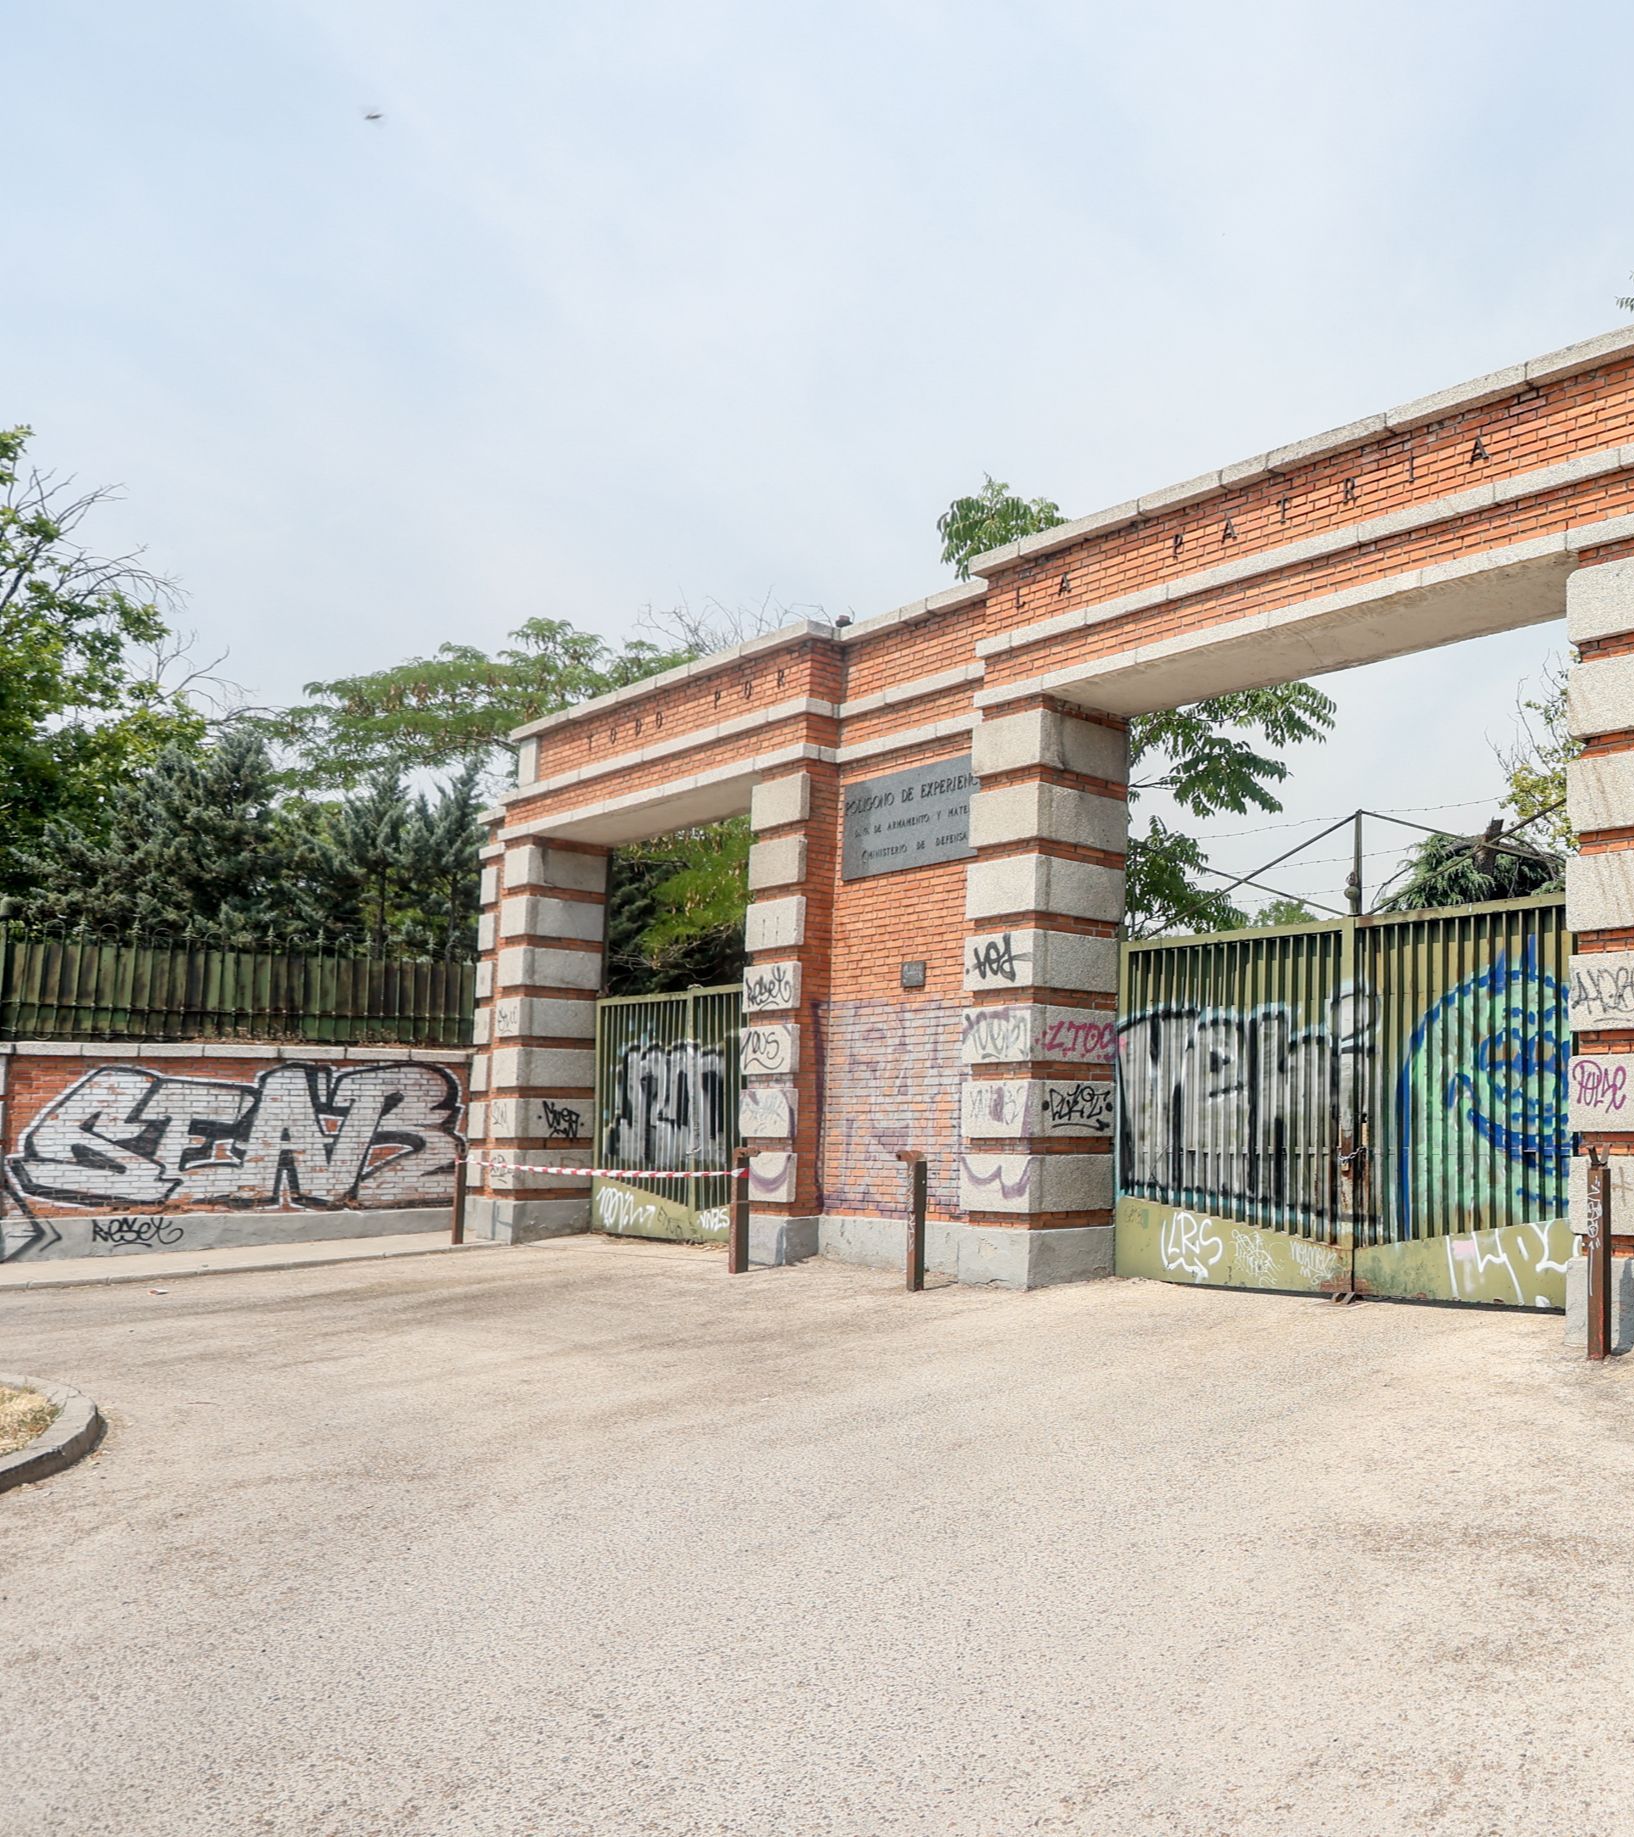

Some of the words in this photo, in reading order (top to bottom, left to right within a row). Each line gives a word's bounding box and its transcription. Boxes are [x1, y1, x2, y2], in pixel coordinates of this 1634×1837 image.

[1014, 571, 1073, 610] LA
[1172, 436, 1491, 562] PATRIA
[586, 710, 665, 751] TODO
[714, 668, 786, 711] POR
[901, 786, 914, 804] DE
[887, 813, 930, 831] ARMAMENTO
[937, 810, 942, 821] Y
[916, 840, 926, 850] DE
[935, 831, 968, 847] DEFENSA
